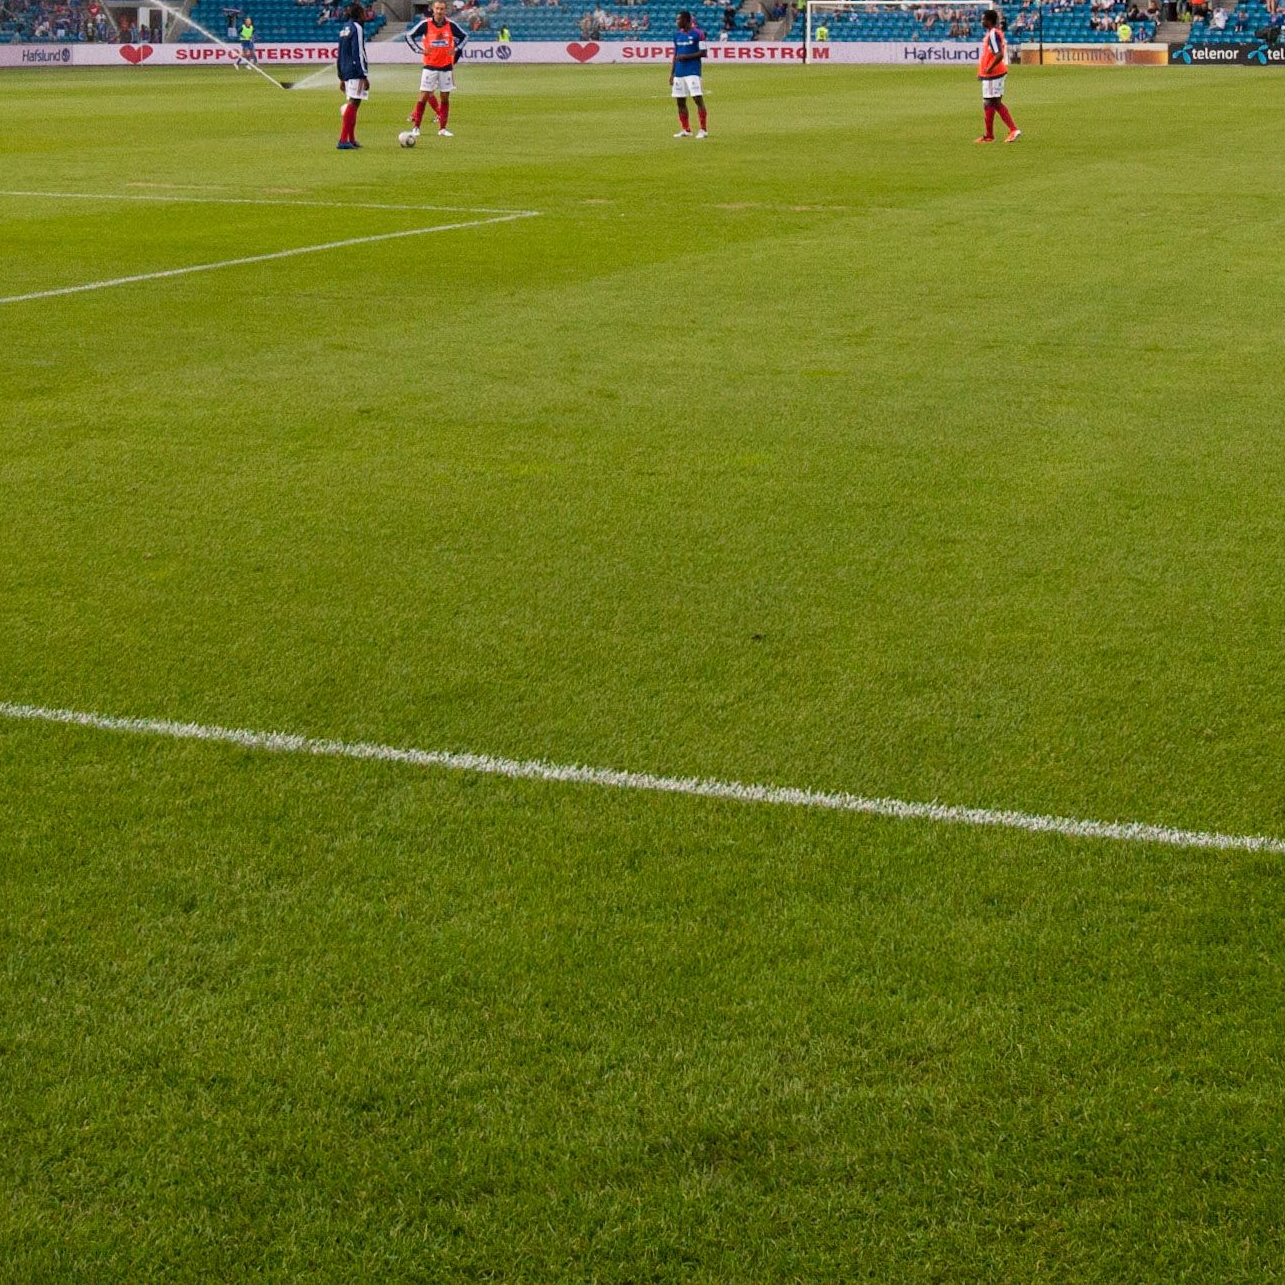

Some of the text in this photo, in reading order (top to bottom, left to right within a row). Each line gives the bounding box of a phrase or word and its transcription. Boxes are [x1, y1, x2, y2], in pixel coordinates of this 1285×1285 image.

[21, 49, 59, 63] Hafslund
[621, 47, 830, 59] SUPPTERSTRØM
[904, 45, 979, 61] Hafslund
[1191, 47, 1239, 60] telenor
